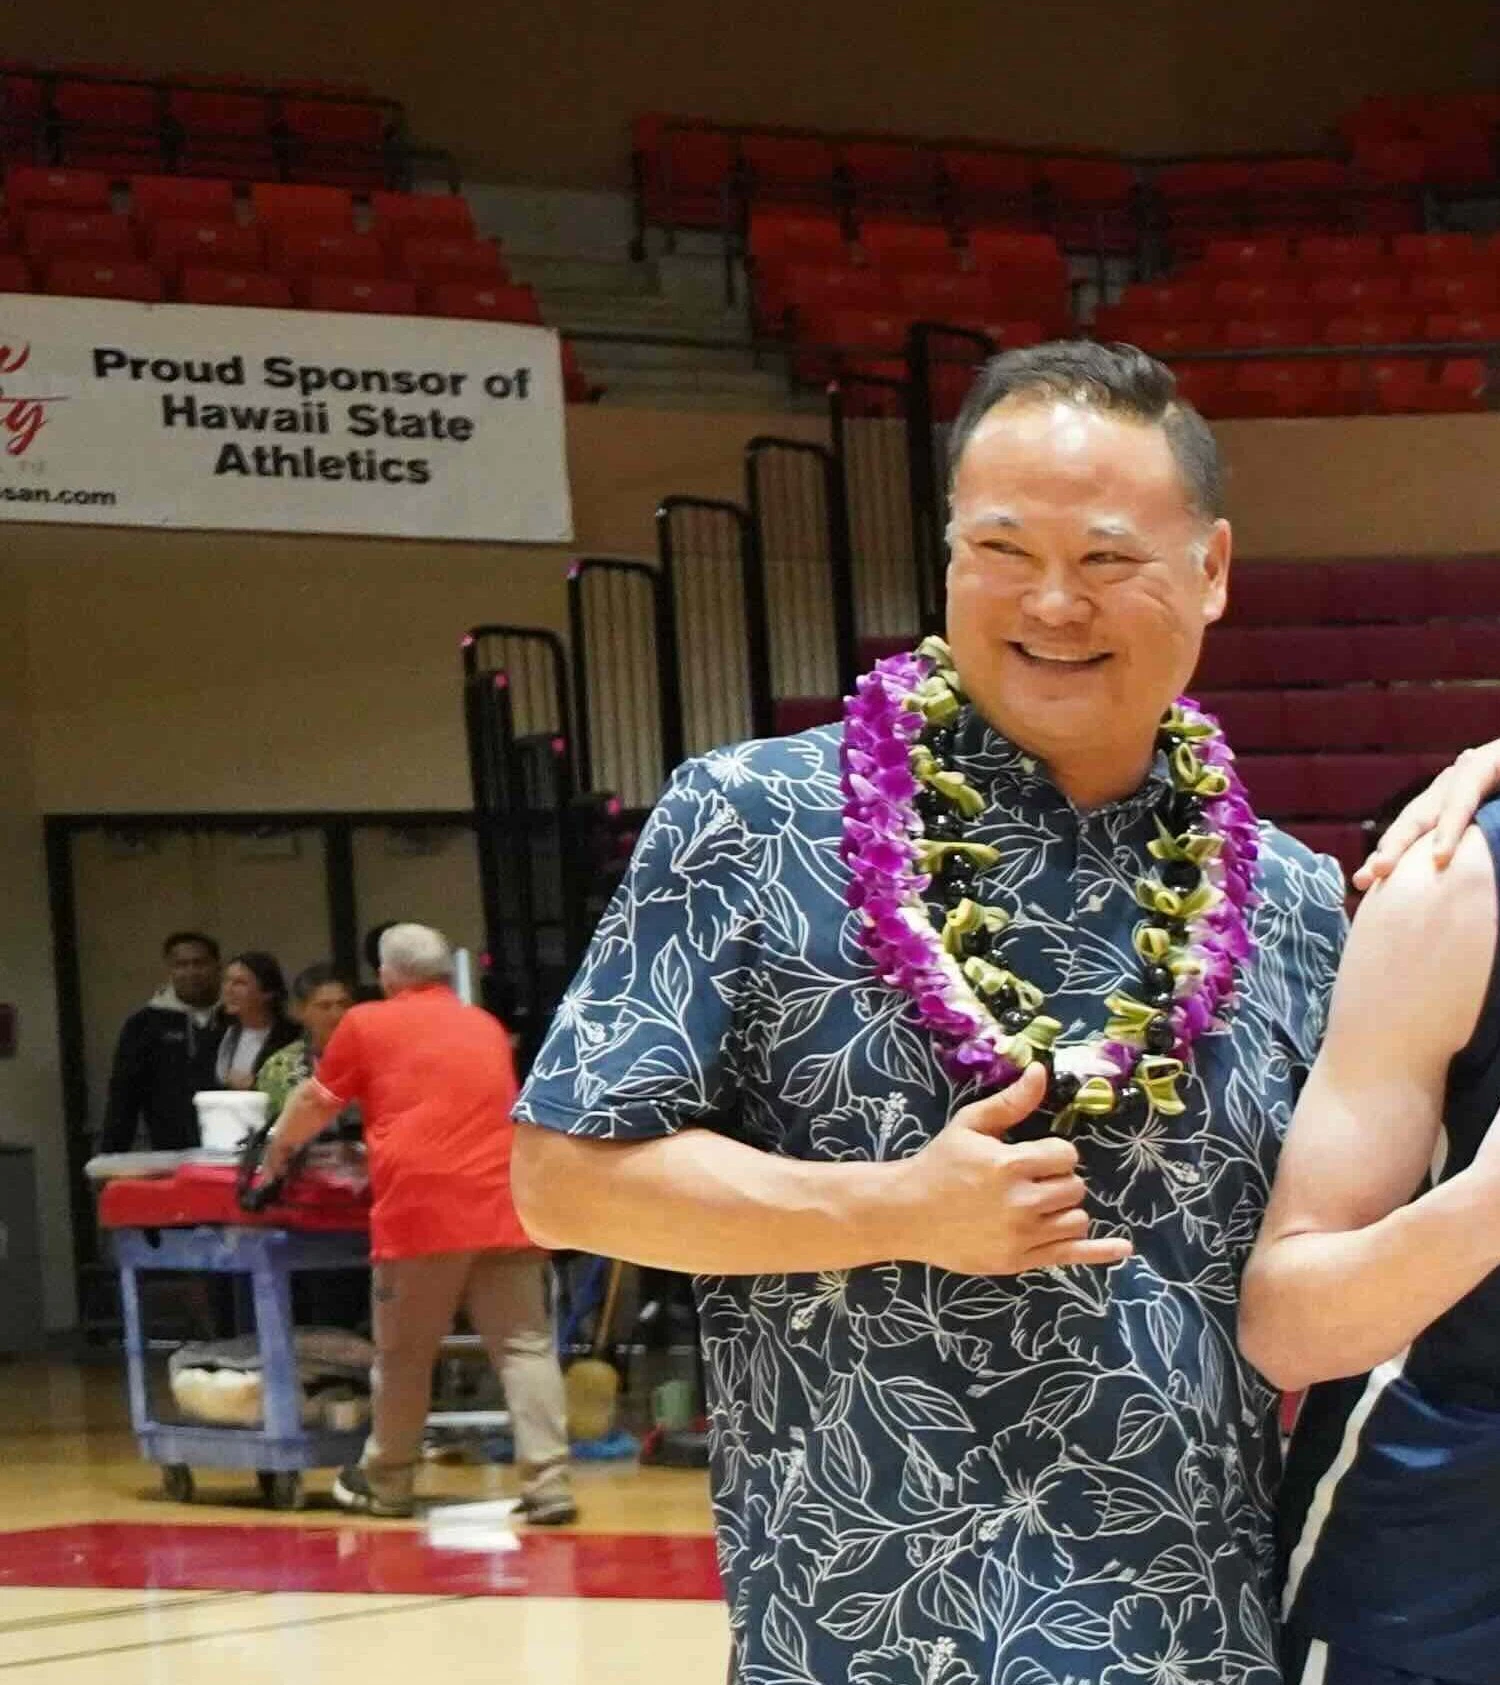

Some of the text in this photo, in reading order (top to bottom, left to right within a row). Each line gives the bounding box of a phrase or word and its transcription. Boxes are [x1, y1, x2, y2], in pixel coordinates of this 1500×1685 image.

[92, 347, 531, 400] Proud Sponsor of
[161, 394, 474, 442] Hawaii State
[213, 443, 431, 485] Athletics
